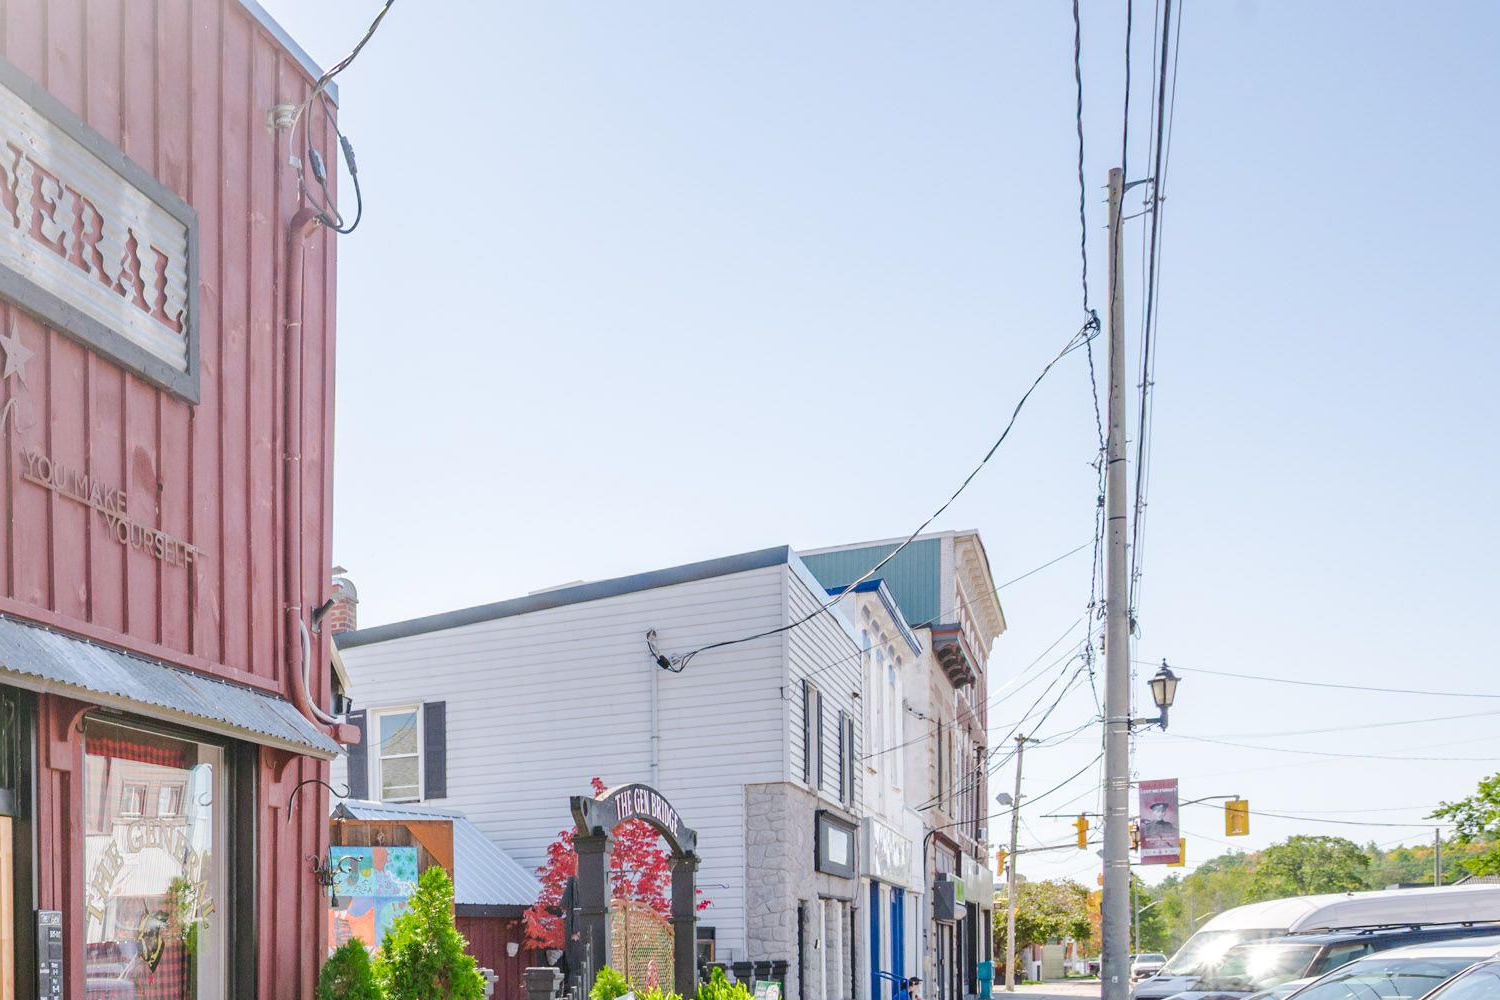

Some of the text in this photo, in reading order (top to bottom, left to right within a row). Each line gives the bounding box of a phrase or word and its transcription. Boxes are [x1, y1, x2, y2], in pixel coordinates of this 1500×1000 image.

[23, 447, 127, 514] YOU MAKE
[103, 511, 194, 569] YOURSELF
[614, 788, 678, 838] THE GEN BRIDGE
